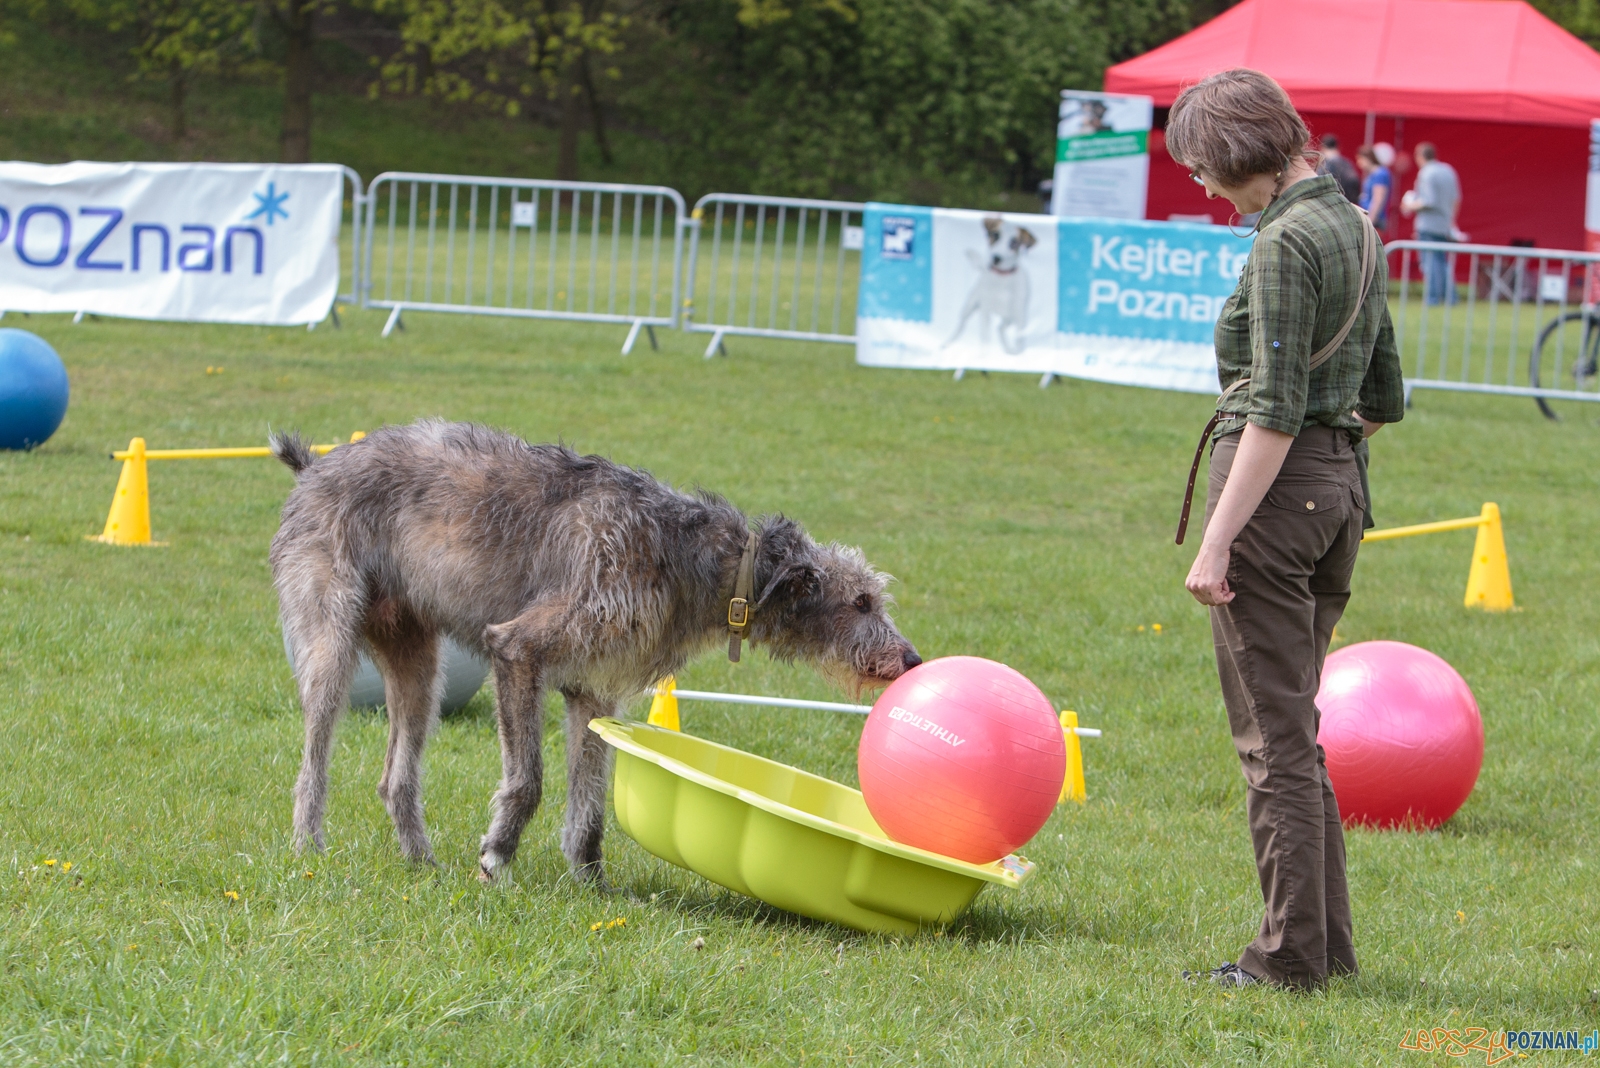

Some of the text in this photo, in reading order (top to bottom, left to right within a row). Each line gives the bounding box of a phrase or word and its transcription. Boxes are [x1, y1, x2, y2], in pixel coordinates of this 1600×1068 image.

[0, 204, 264, 274] OZnan
[1092, 234, 1209, 281] Kejter
[902, 711, 966, 747] ATHLETIC
